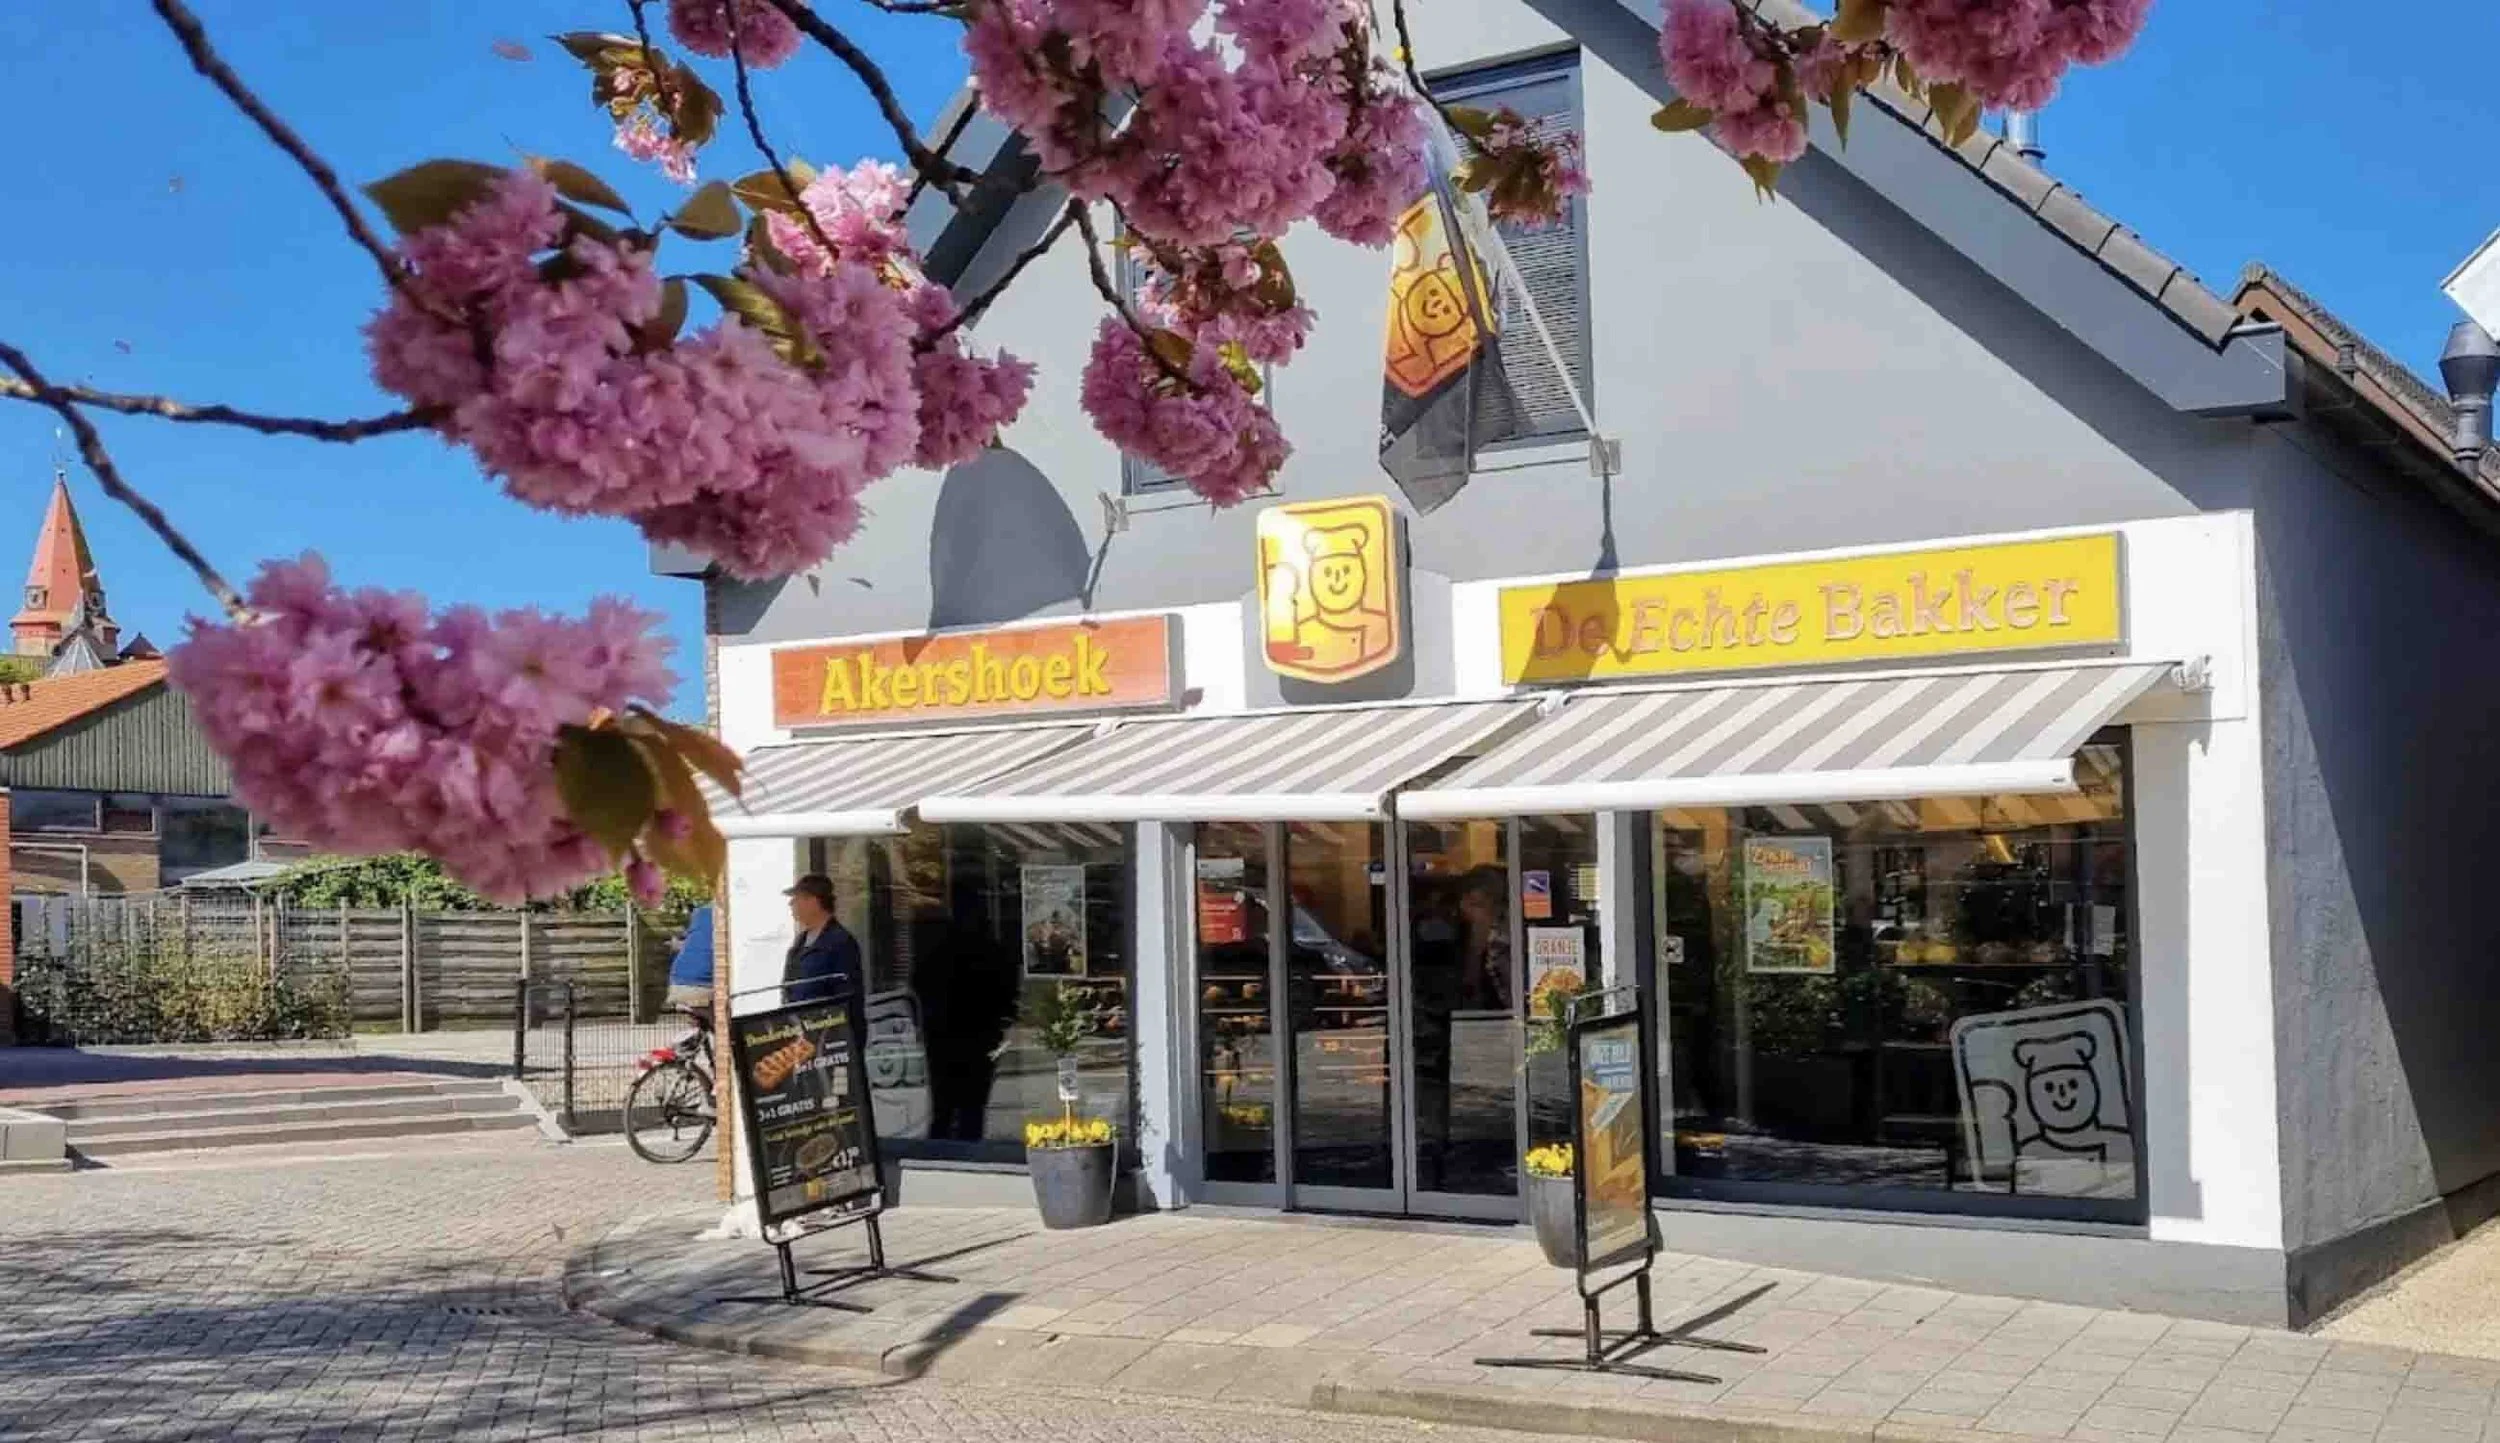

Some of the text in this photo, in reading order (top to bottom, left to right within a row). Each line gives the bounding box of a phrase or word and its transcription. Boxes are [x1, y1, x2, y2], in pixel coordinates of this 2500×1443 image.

[1530, 569, 2081, 660] De Echte Bakker
[818, 633, 1113, 717] Akershoek
[777, 1097, 817, 1117] GRATIS
